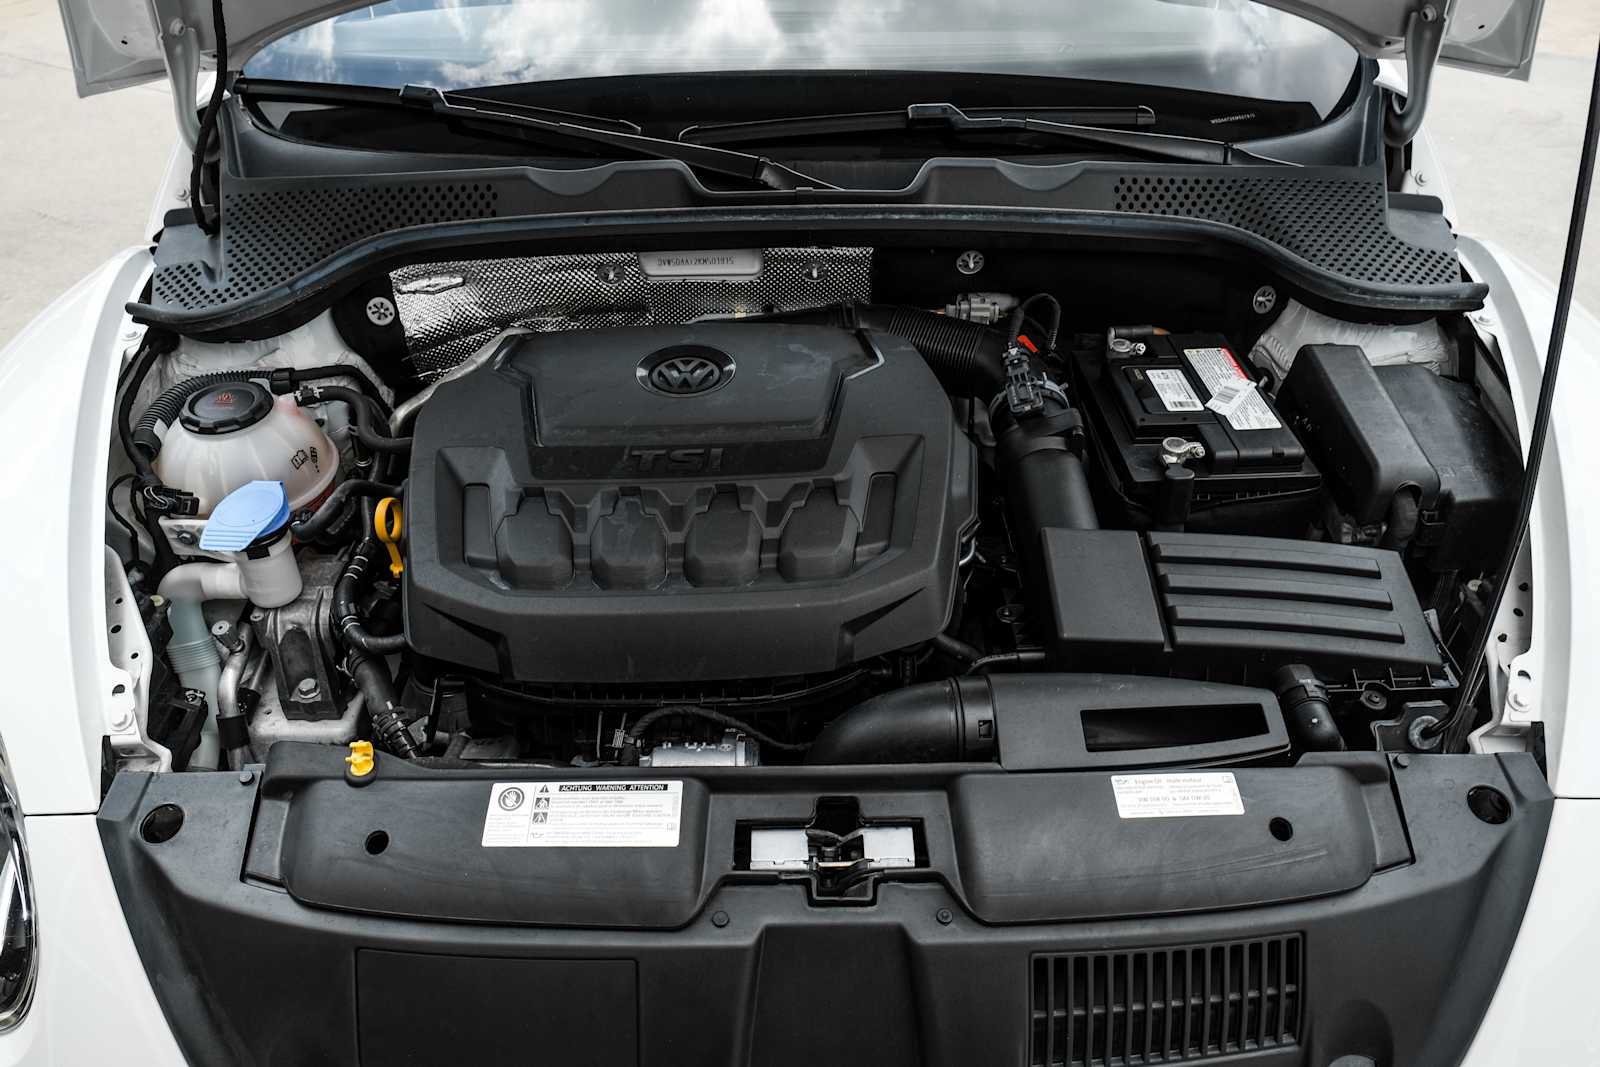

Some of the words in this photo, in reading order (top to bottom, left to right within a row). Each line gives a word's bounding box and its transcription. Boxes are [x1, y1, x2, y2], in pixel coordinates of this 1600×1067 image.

[631, 447, 723, 472] TSI
[561, 784, 593, 792] ACHTUNG
[595, 784, 627, 792] WARNING
